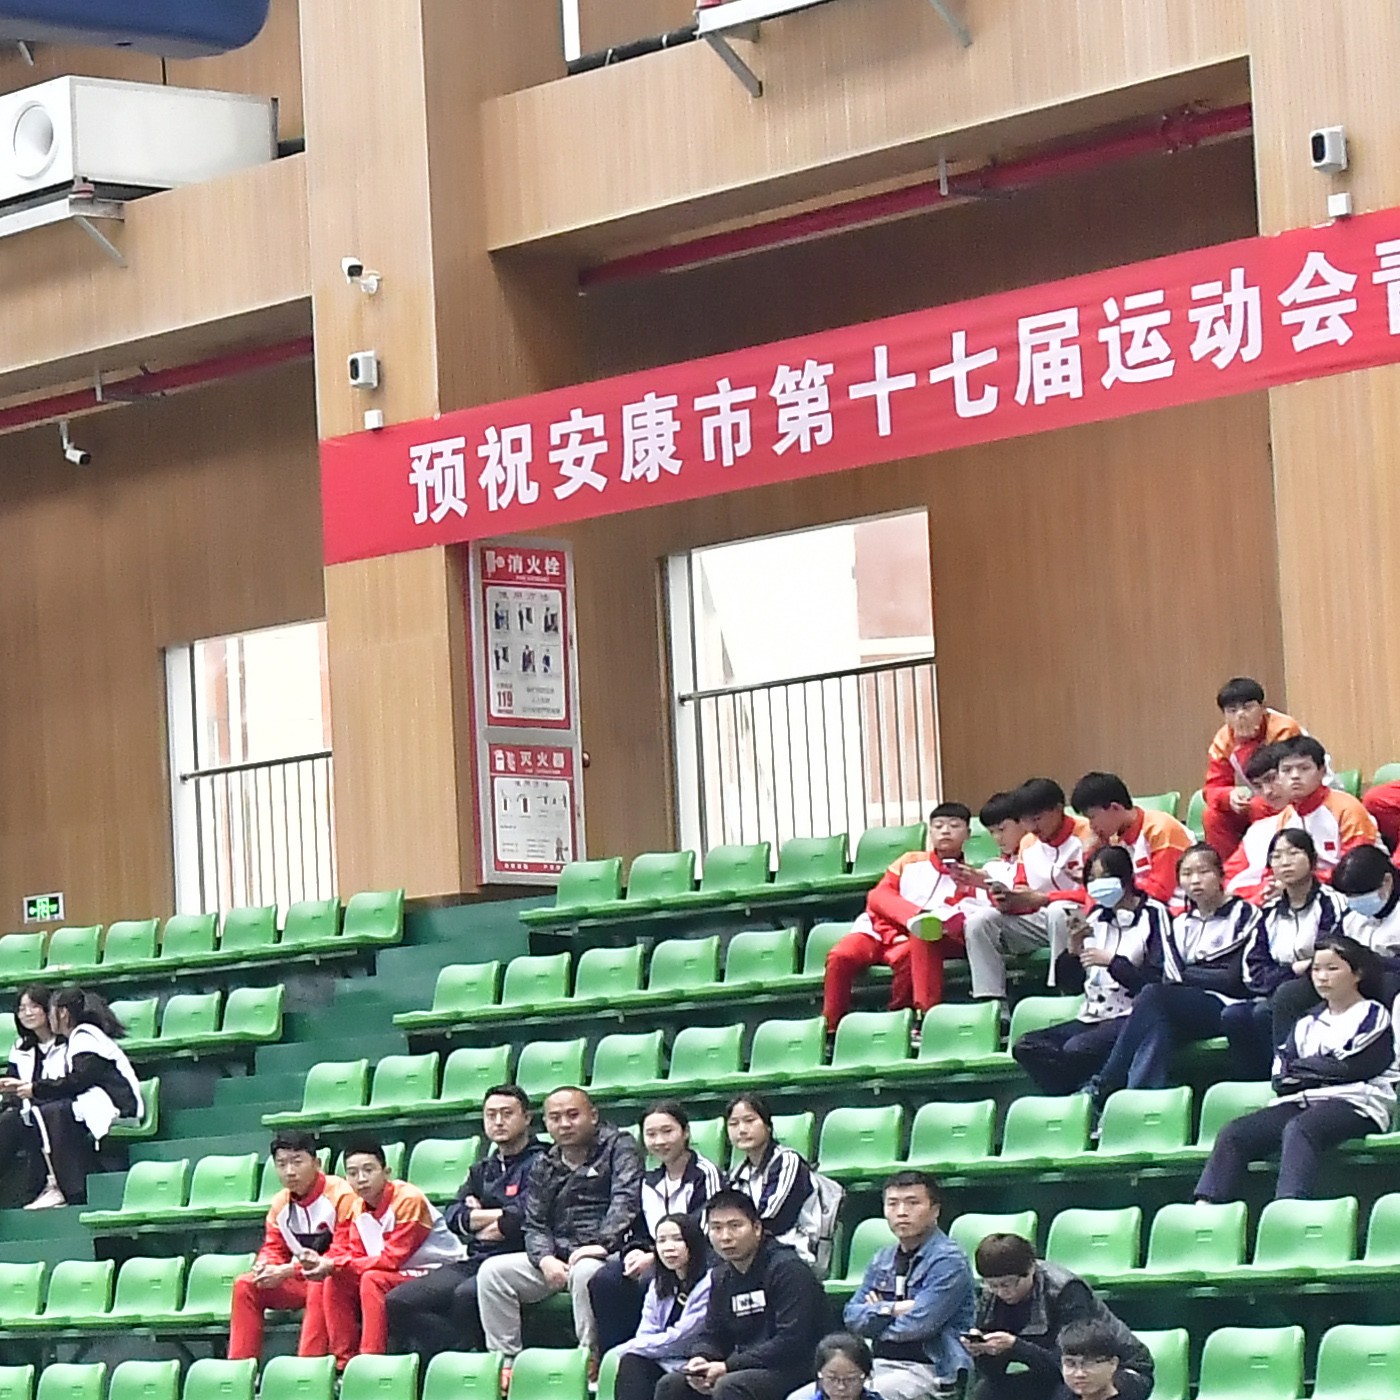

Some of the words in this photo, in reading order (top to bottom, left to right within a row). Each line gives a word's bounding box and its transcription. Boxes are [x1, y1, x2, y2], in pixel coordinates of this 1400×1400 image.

[508, 554, 561, 576] 消火栓
[497, 691, 514, 708] 119
